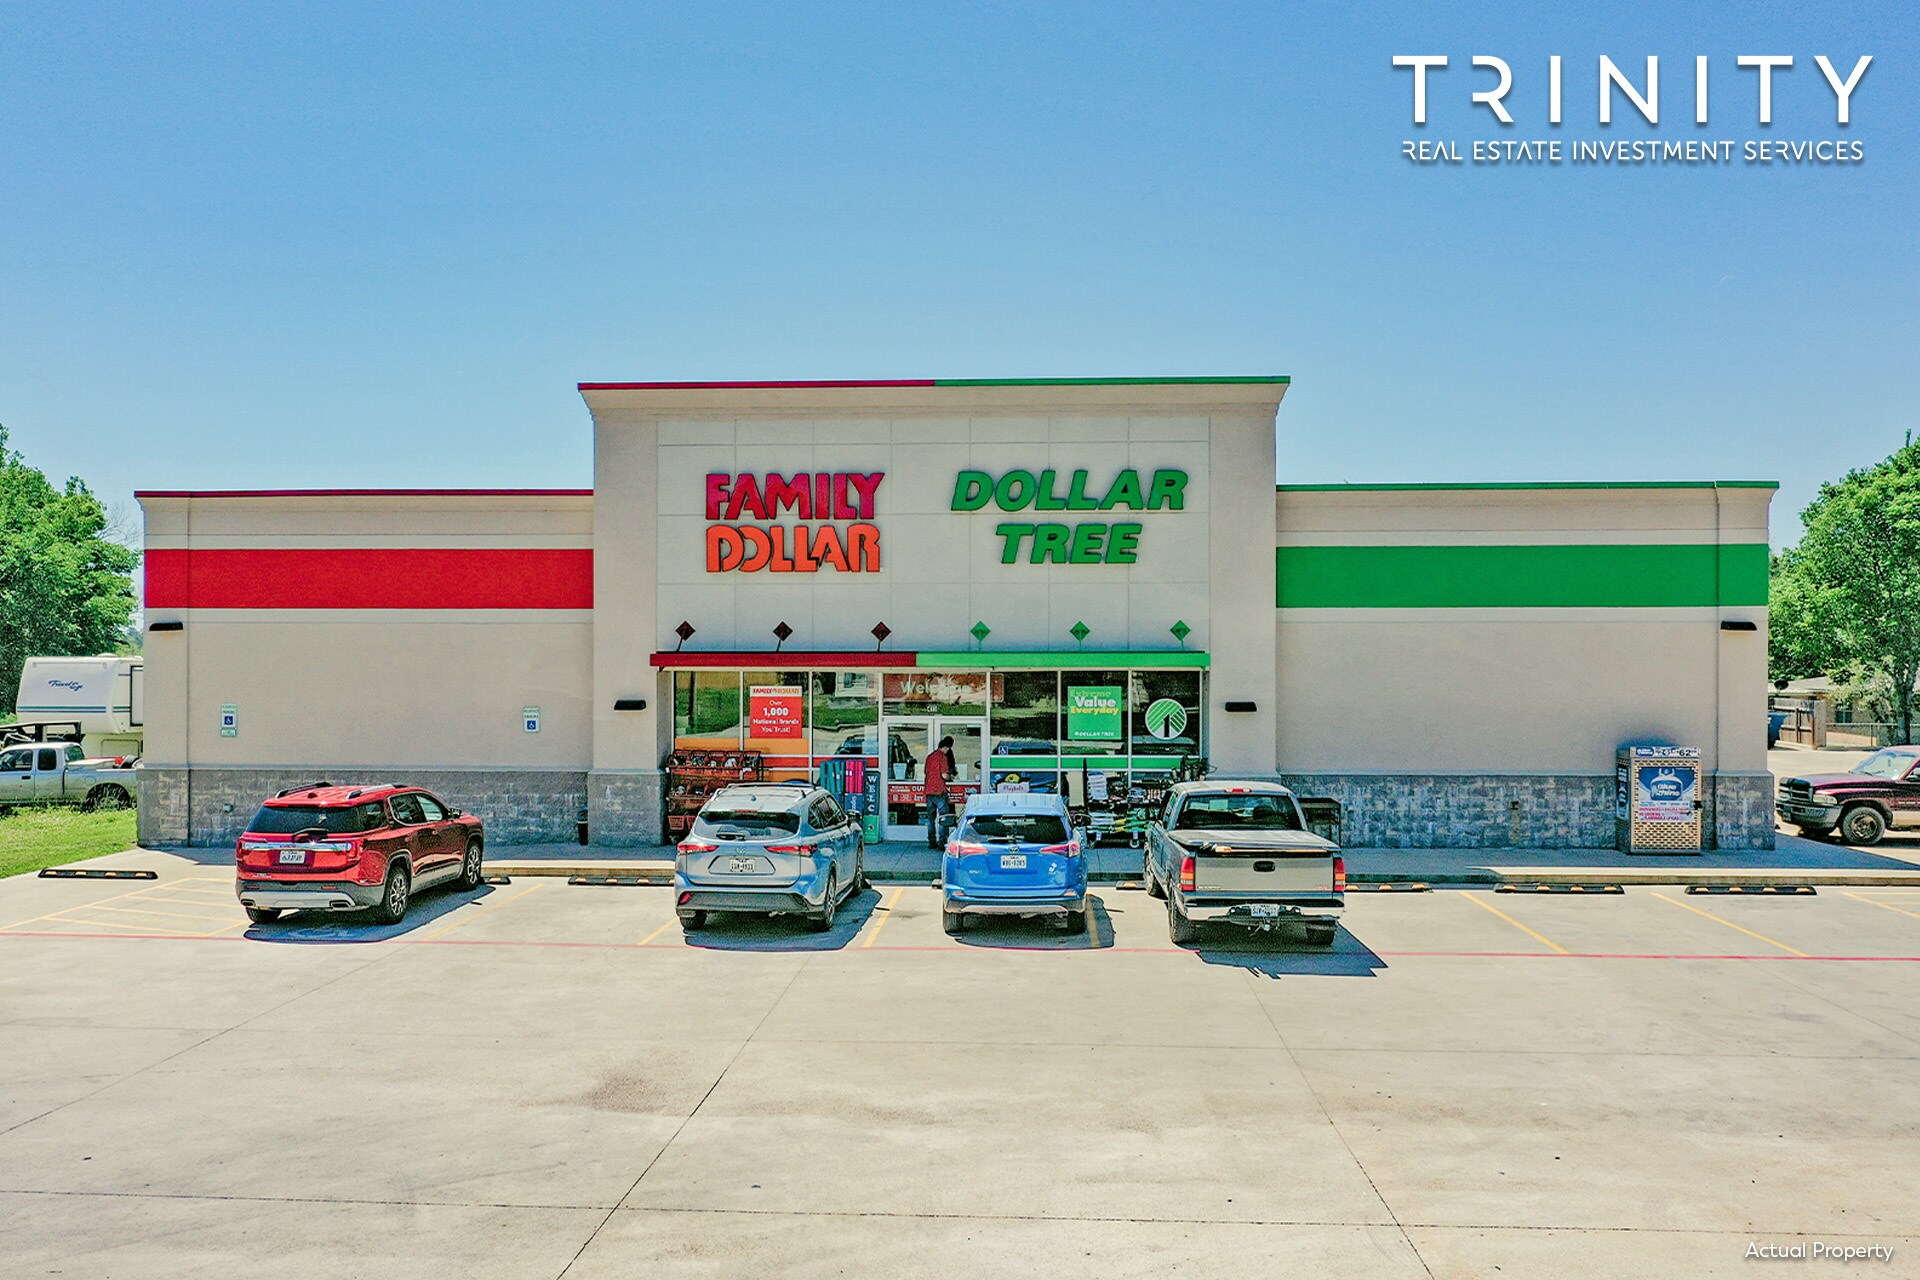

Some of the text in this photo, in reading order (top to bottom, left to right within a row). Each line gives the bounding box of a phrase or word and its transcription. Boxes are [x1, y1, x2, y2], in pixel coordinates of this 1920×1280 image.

[705, 472, 885, 521] FAMILY
[950, 469, 1189, 512] DOLLAR
[705, 523, 881, 573] DOLLAR
[995, 523, 1143, 565] TREE
[1070, 689, 1111, 698] Extreme
[1074, 696, 1116, 707] Value
[763, 707, 788, 717] 1,000
[1070, 706, 1119, 716] Everyday
